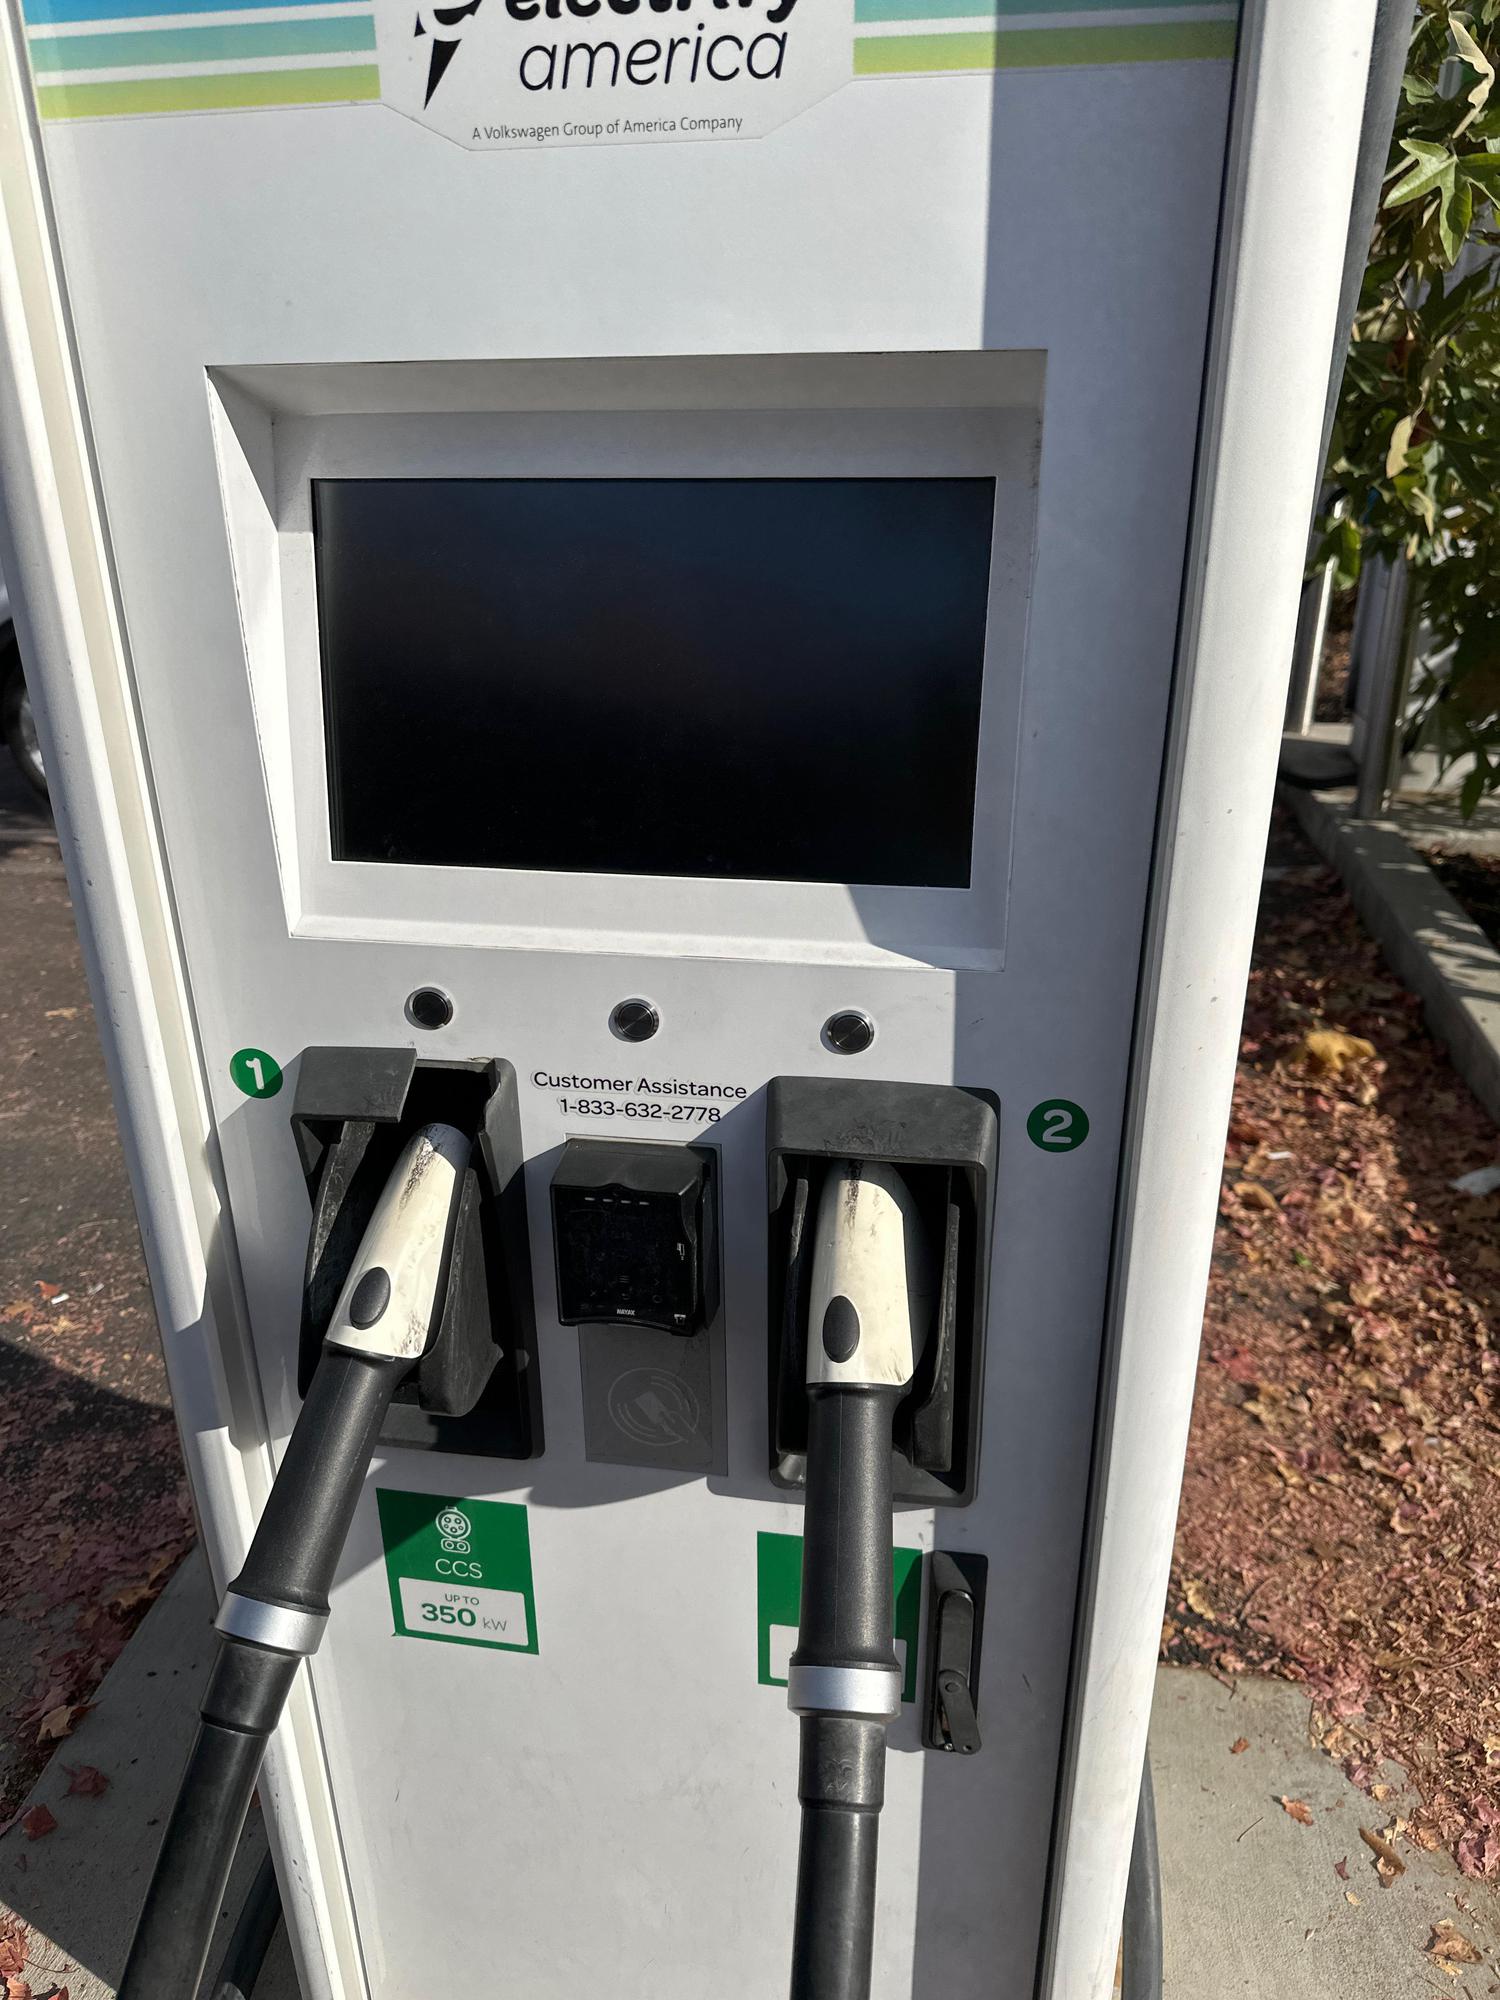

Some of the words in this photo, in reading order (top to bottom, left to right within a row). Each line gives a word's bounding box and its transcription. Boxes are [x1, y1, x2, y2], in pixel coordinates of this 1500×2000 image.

[519, 23, 788, 91] america
[472, 127, 481, 140] A
[485, 125, 559, 141] Volkswagen
[563, 122, 603, 138] Group
[607, 119, 620, 134] of
[623, 117, 676, 133] America
[680, 116, 743, 132] Company
[245, 1057, 265, 1090] 1
[533, 1071, 634, 1093] Customer
[637, 1078, 747, 1099] Assistance
[560, 1098, 721, 1123] 1-833-632-2778
[1042, 1108, 1073, 1144] 2
[435, 1558, 483, 1579] CCS
[445, 1593, 461, 1603] UP
[462, 1596, 480, 1606] TO
[421, 1602, 477, 1627] 350
[482, 1616, 507, 1632] kW
